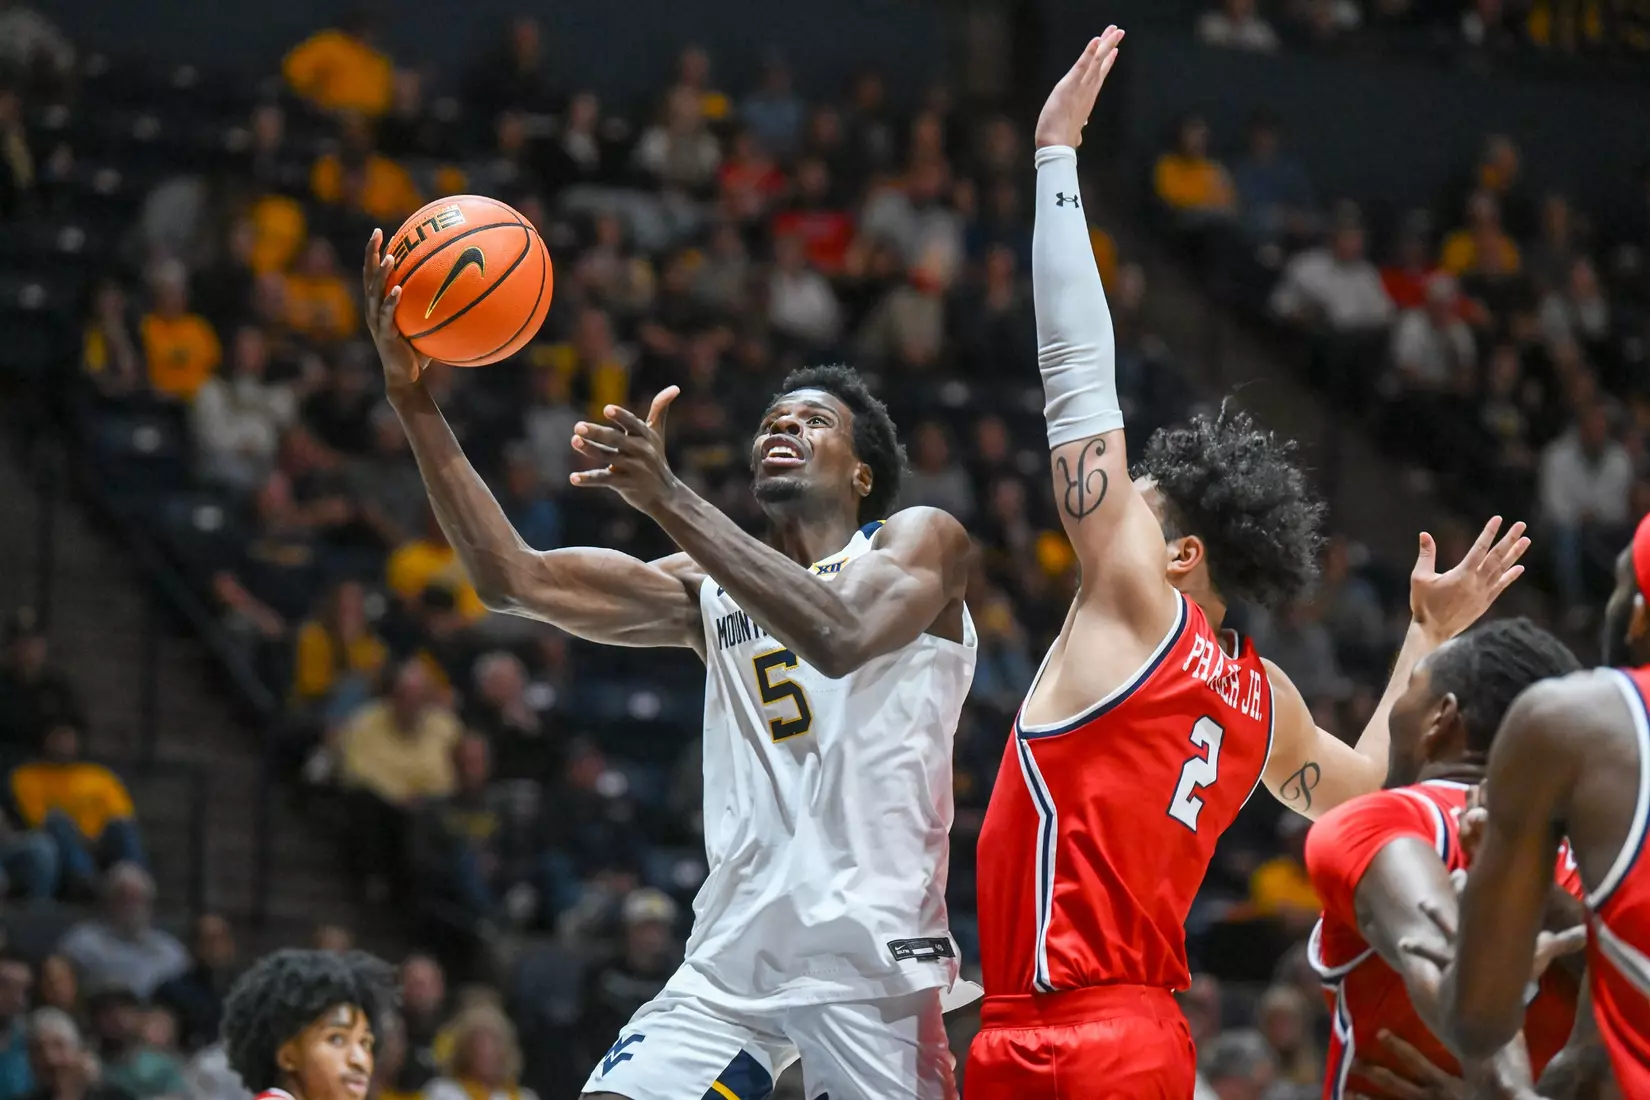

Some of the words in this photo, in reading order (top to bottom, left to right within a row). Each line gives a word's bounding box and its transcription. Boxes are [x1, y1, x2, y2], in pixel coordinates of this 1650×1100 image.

[392, 204, 466, 271] ELITE
[752, 647, 811, 744] 5
[1241, 669, 1262, 722] JR.
[1166, 714, 1225, 834] 2
